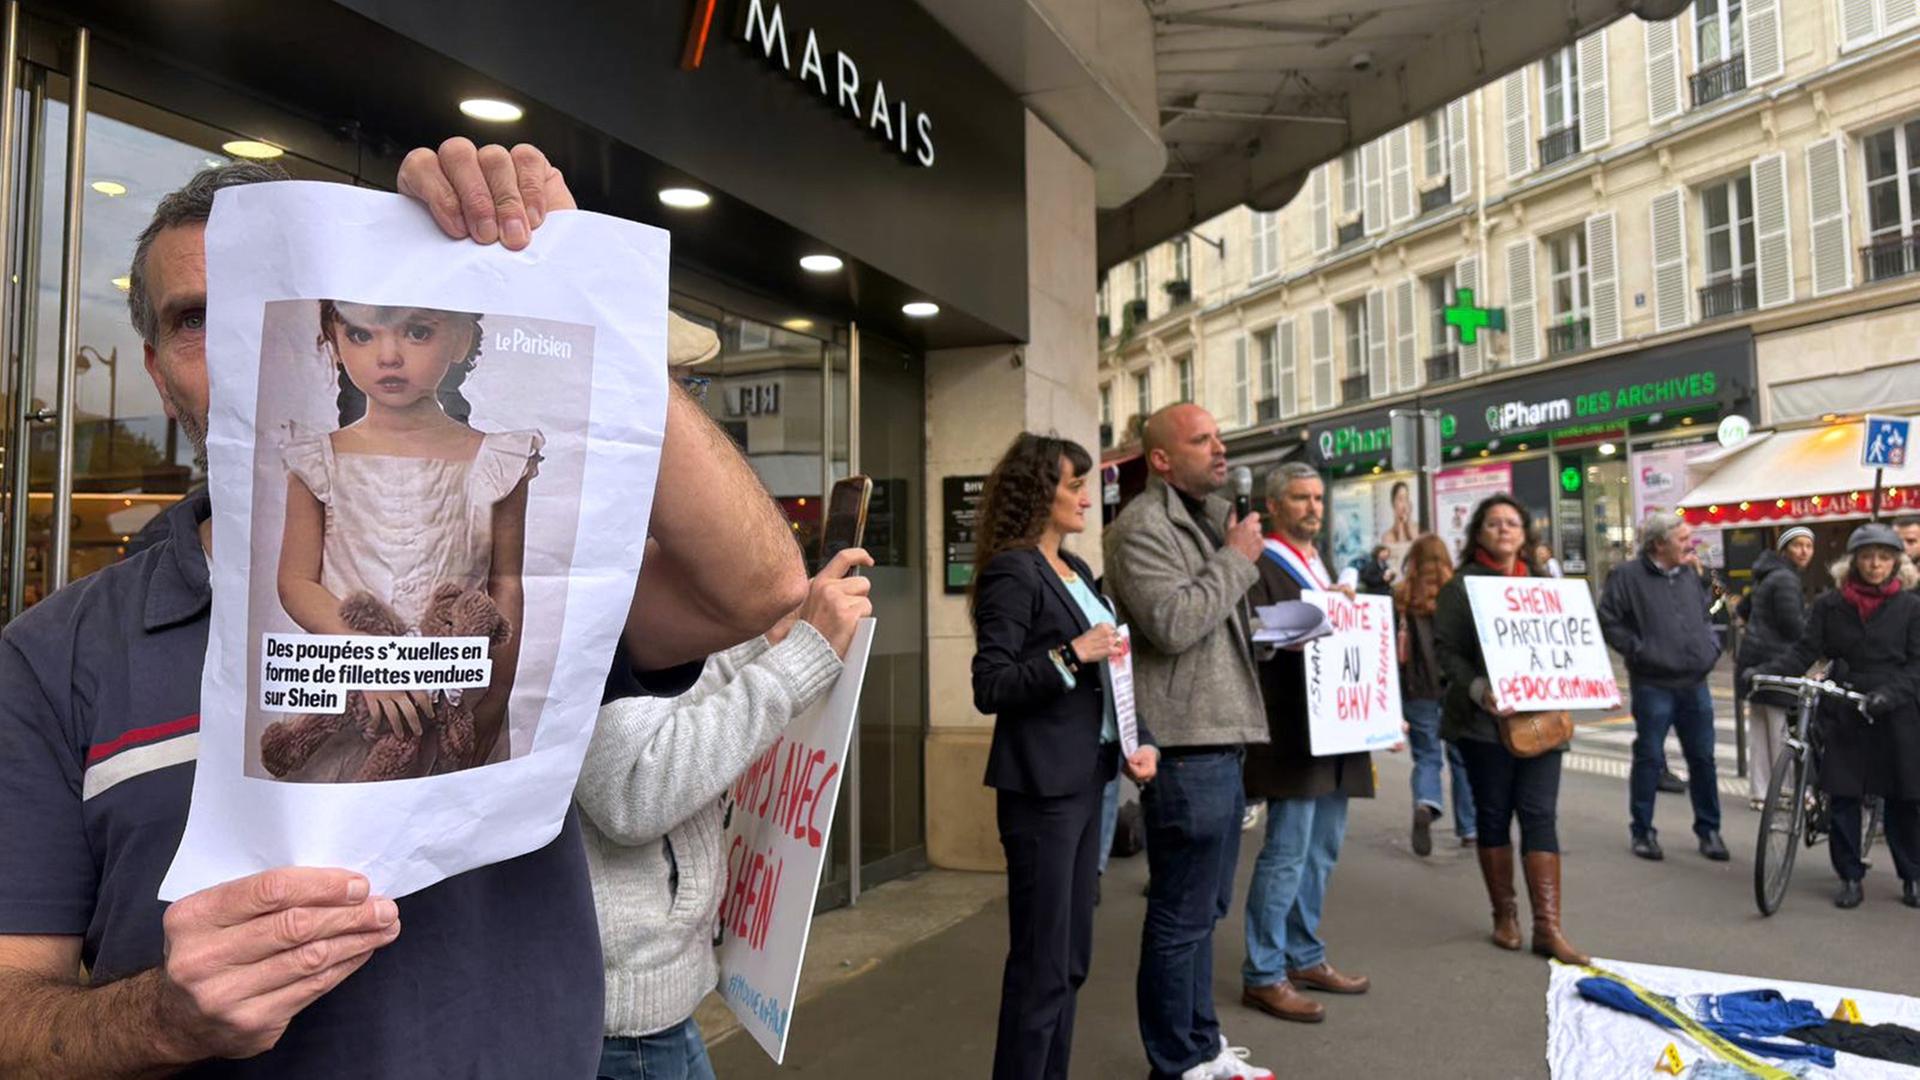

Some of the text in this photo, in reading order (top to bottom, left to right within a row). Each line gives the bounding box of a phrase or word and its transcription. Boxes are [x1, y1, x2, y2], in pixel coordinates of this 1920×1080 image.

[744, 0, 934, 167] MARAIS
[495, 328, 571, 359] Le Parisien
[1500, 398, 1571, 430] iPharm
[1576, 391, 1611, 417] DES
[1615, 371, 1716, 409] ARCHIVES
[1327, 598, 1371, 631] HONTE
[267, 638, 294, 658] Des
[296, 640, 375, 663] poupées
[461, 645, 482, 660] en
[1342, 645, 1360, 682] AU
[1552, 649, 1574, 669] LA
[266, 662, 484, 684] forme de fillettes vendues
[265, 687, 338, 708] sur Shein
[1337, 684, 1370, 720] BHV
[772, 742, 838, 848] AVEC
